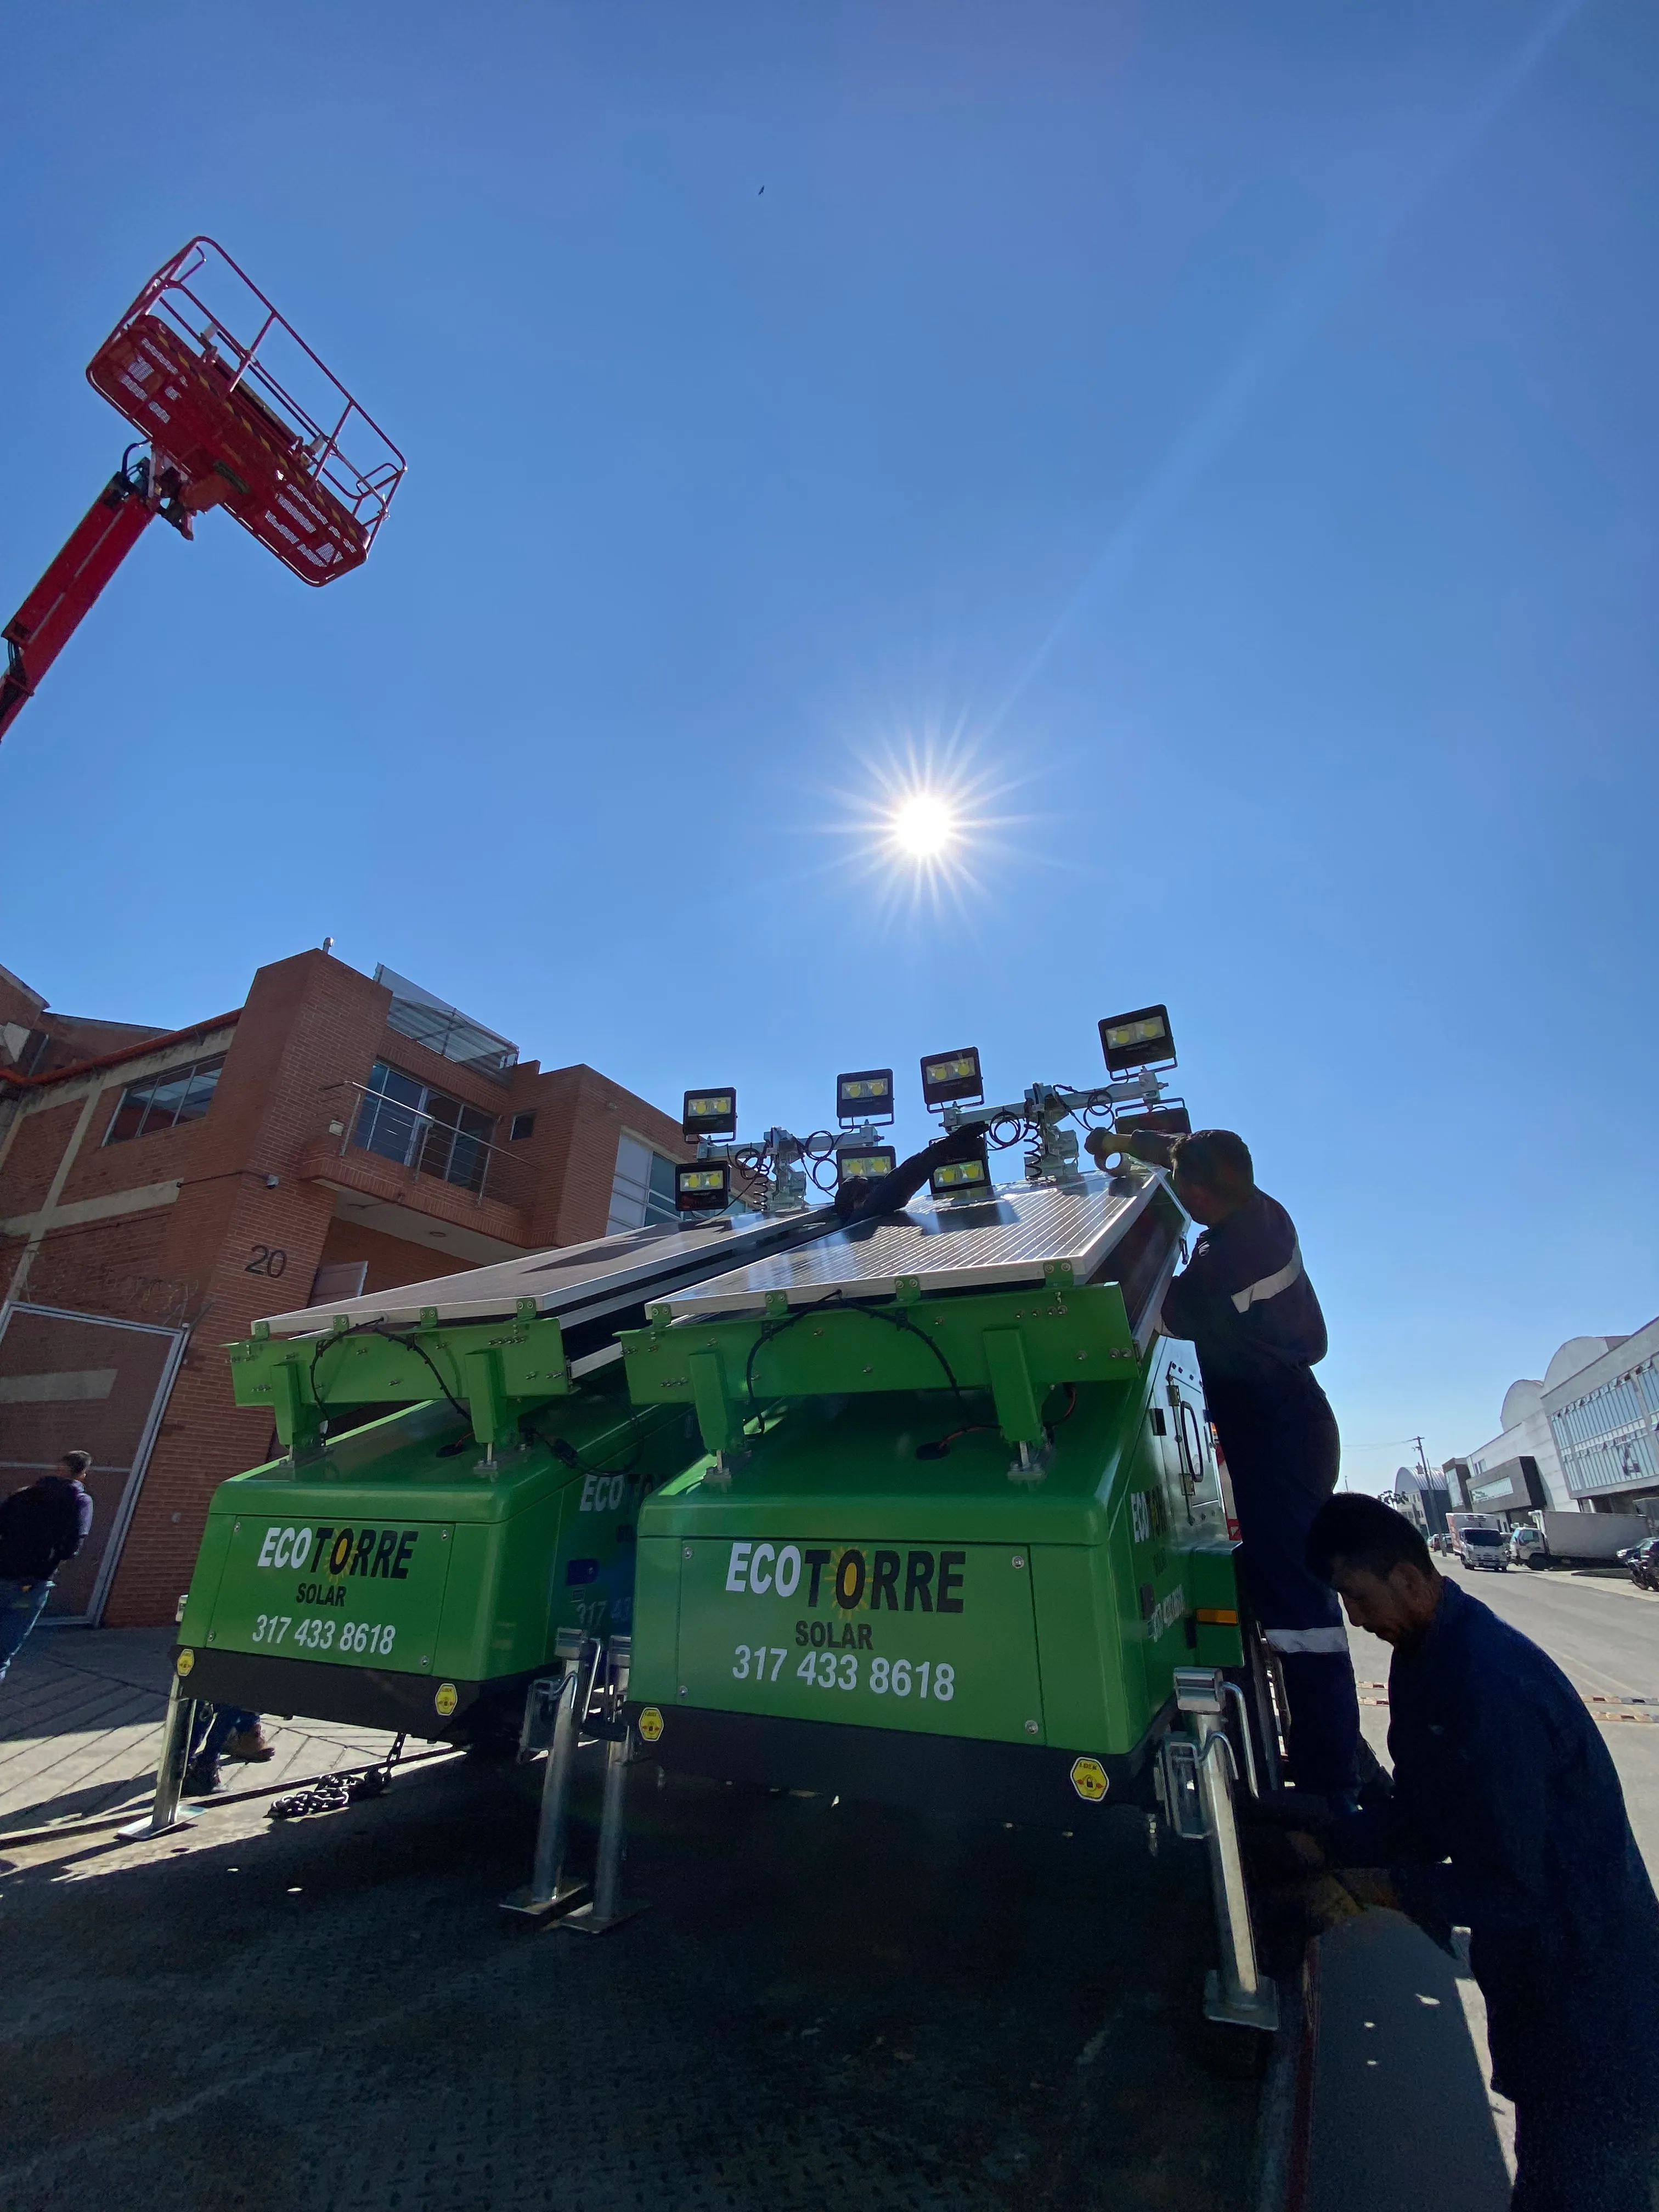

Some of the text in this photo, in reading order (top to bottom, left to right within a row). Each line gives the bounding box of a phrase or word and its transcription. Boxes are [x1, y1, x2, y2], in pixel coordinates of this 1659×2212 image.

[245, 1245, 287, 1278] 20
[257, 1527, 419, 1579] ECOTORRE
[296, 1583, 347, 1607] SOLAR
[725, 1542, 966, 1613] ECOTORRE
[252, 1615, 396, 1655] 317 433 8618
[795, 1620, 874, 1650] SOLAR
[732, 1645, 955, 1701] 317 433 8618
